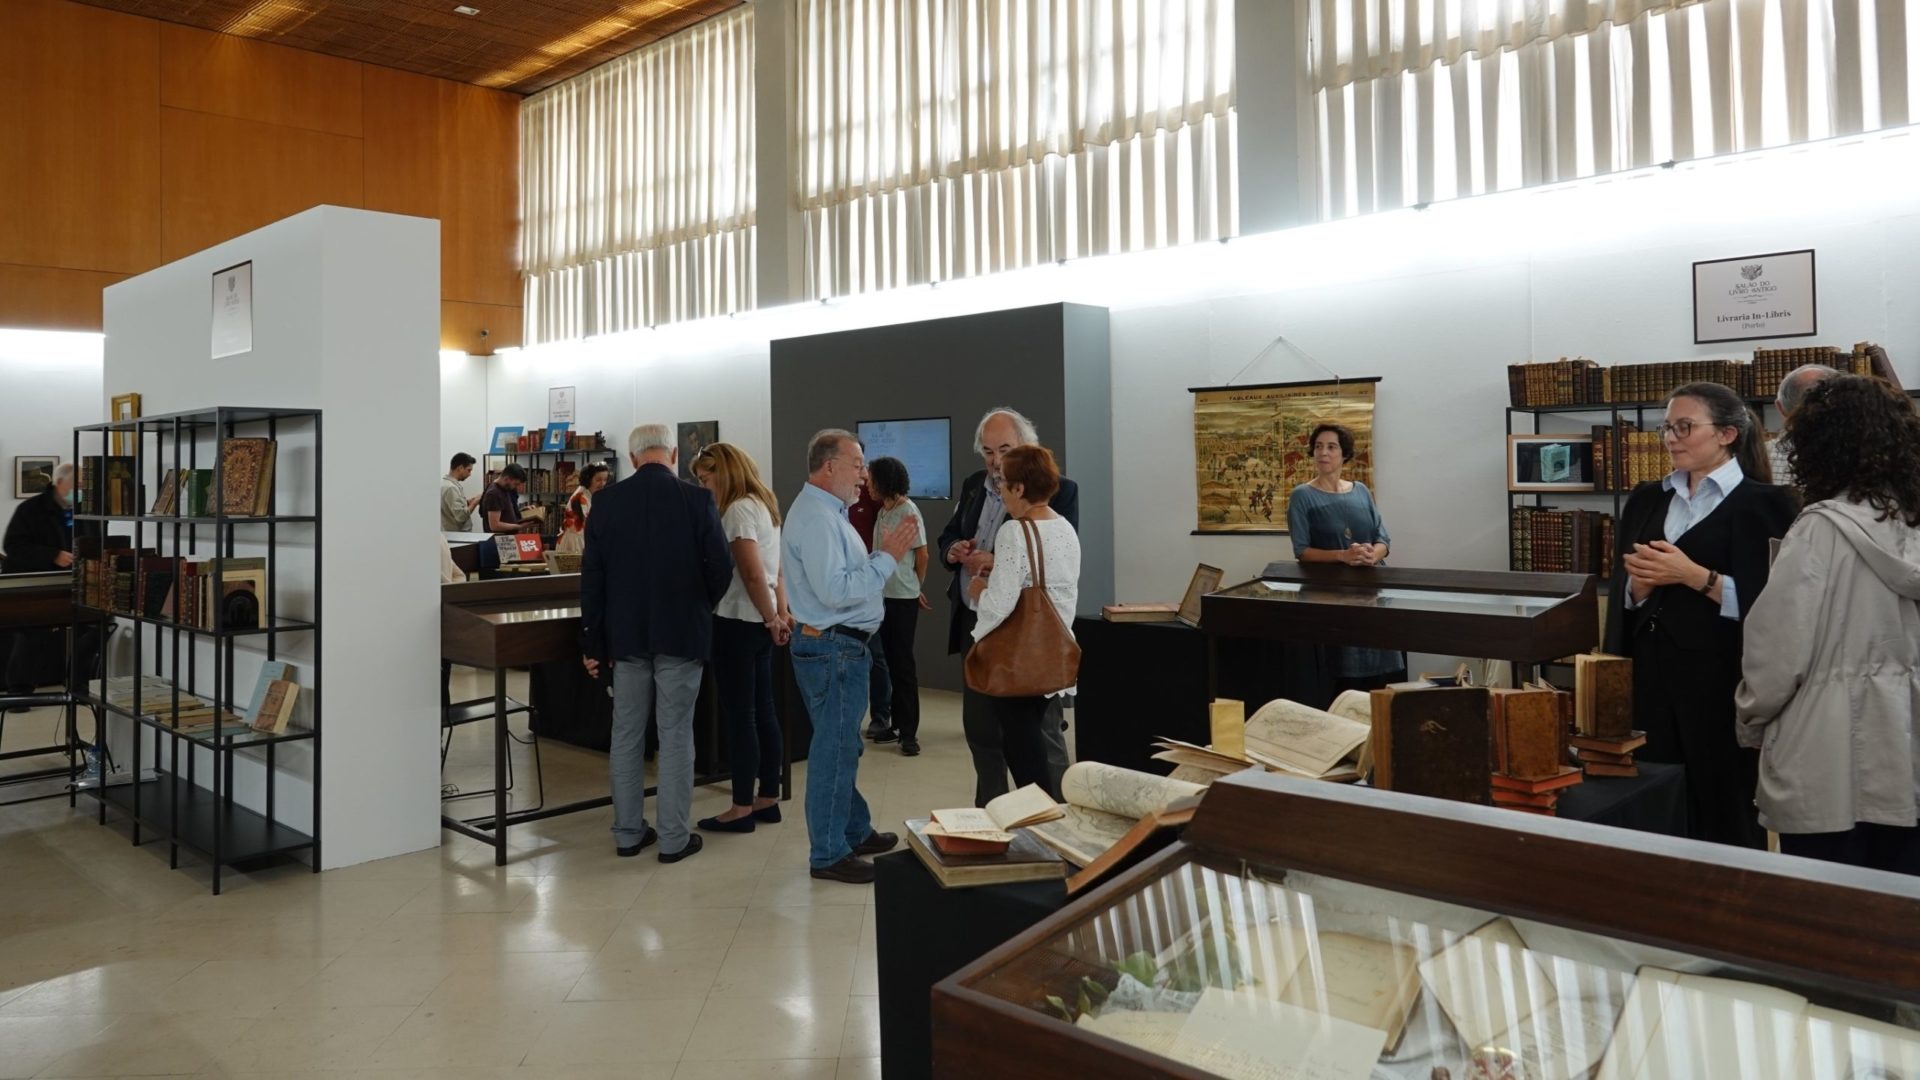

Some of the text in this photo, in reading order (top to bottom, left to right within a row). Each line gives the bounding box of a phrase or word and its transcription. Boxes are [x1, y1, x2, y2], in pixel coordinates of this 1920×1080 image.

[1751, 285, 1777, 293] ANTIGO
[1717, 310, 1791, 323] Livraria In-Libris
